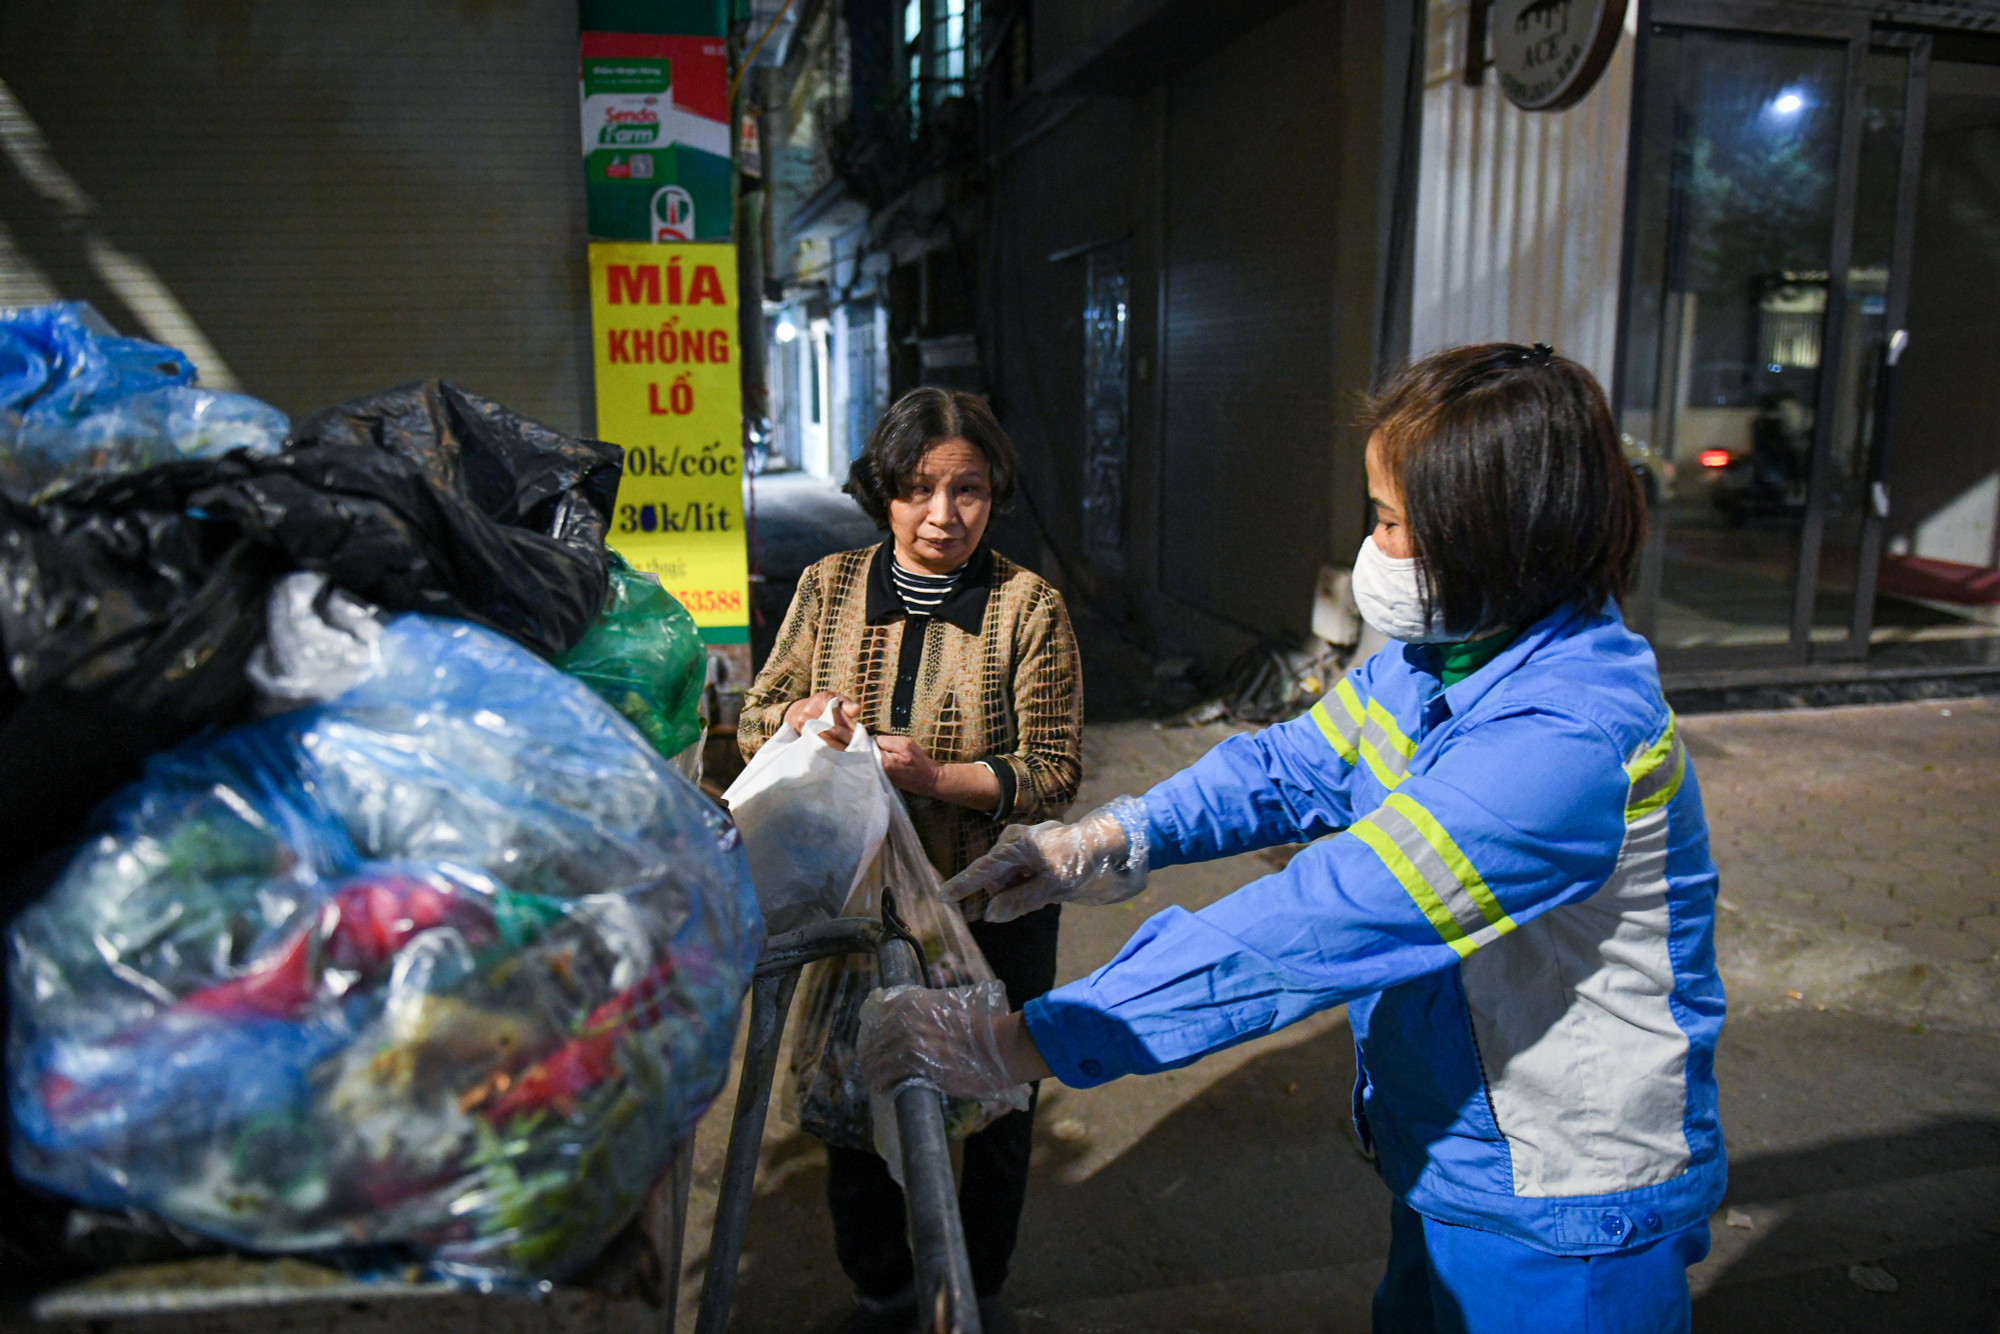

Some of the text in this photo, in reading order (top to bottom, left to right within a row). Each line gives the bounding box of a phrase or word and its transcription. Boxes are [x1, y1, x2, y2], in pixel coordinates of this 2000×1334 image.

[605, 106, 658, 124] Sendo
[604, 124, 654, 143] Farm
[607, 255, 726, 305] MÍA
[608, 315, 729, 364] KHỔNG
[622, 441, 737, 477] 0k/cốc
[670, 589, 742, 614] 53588
